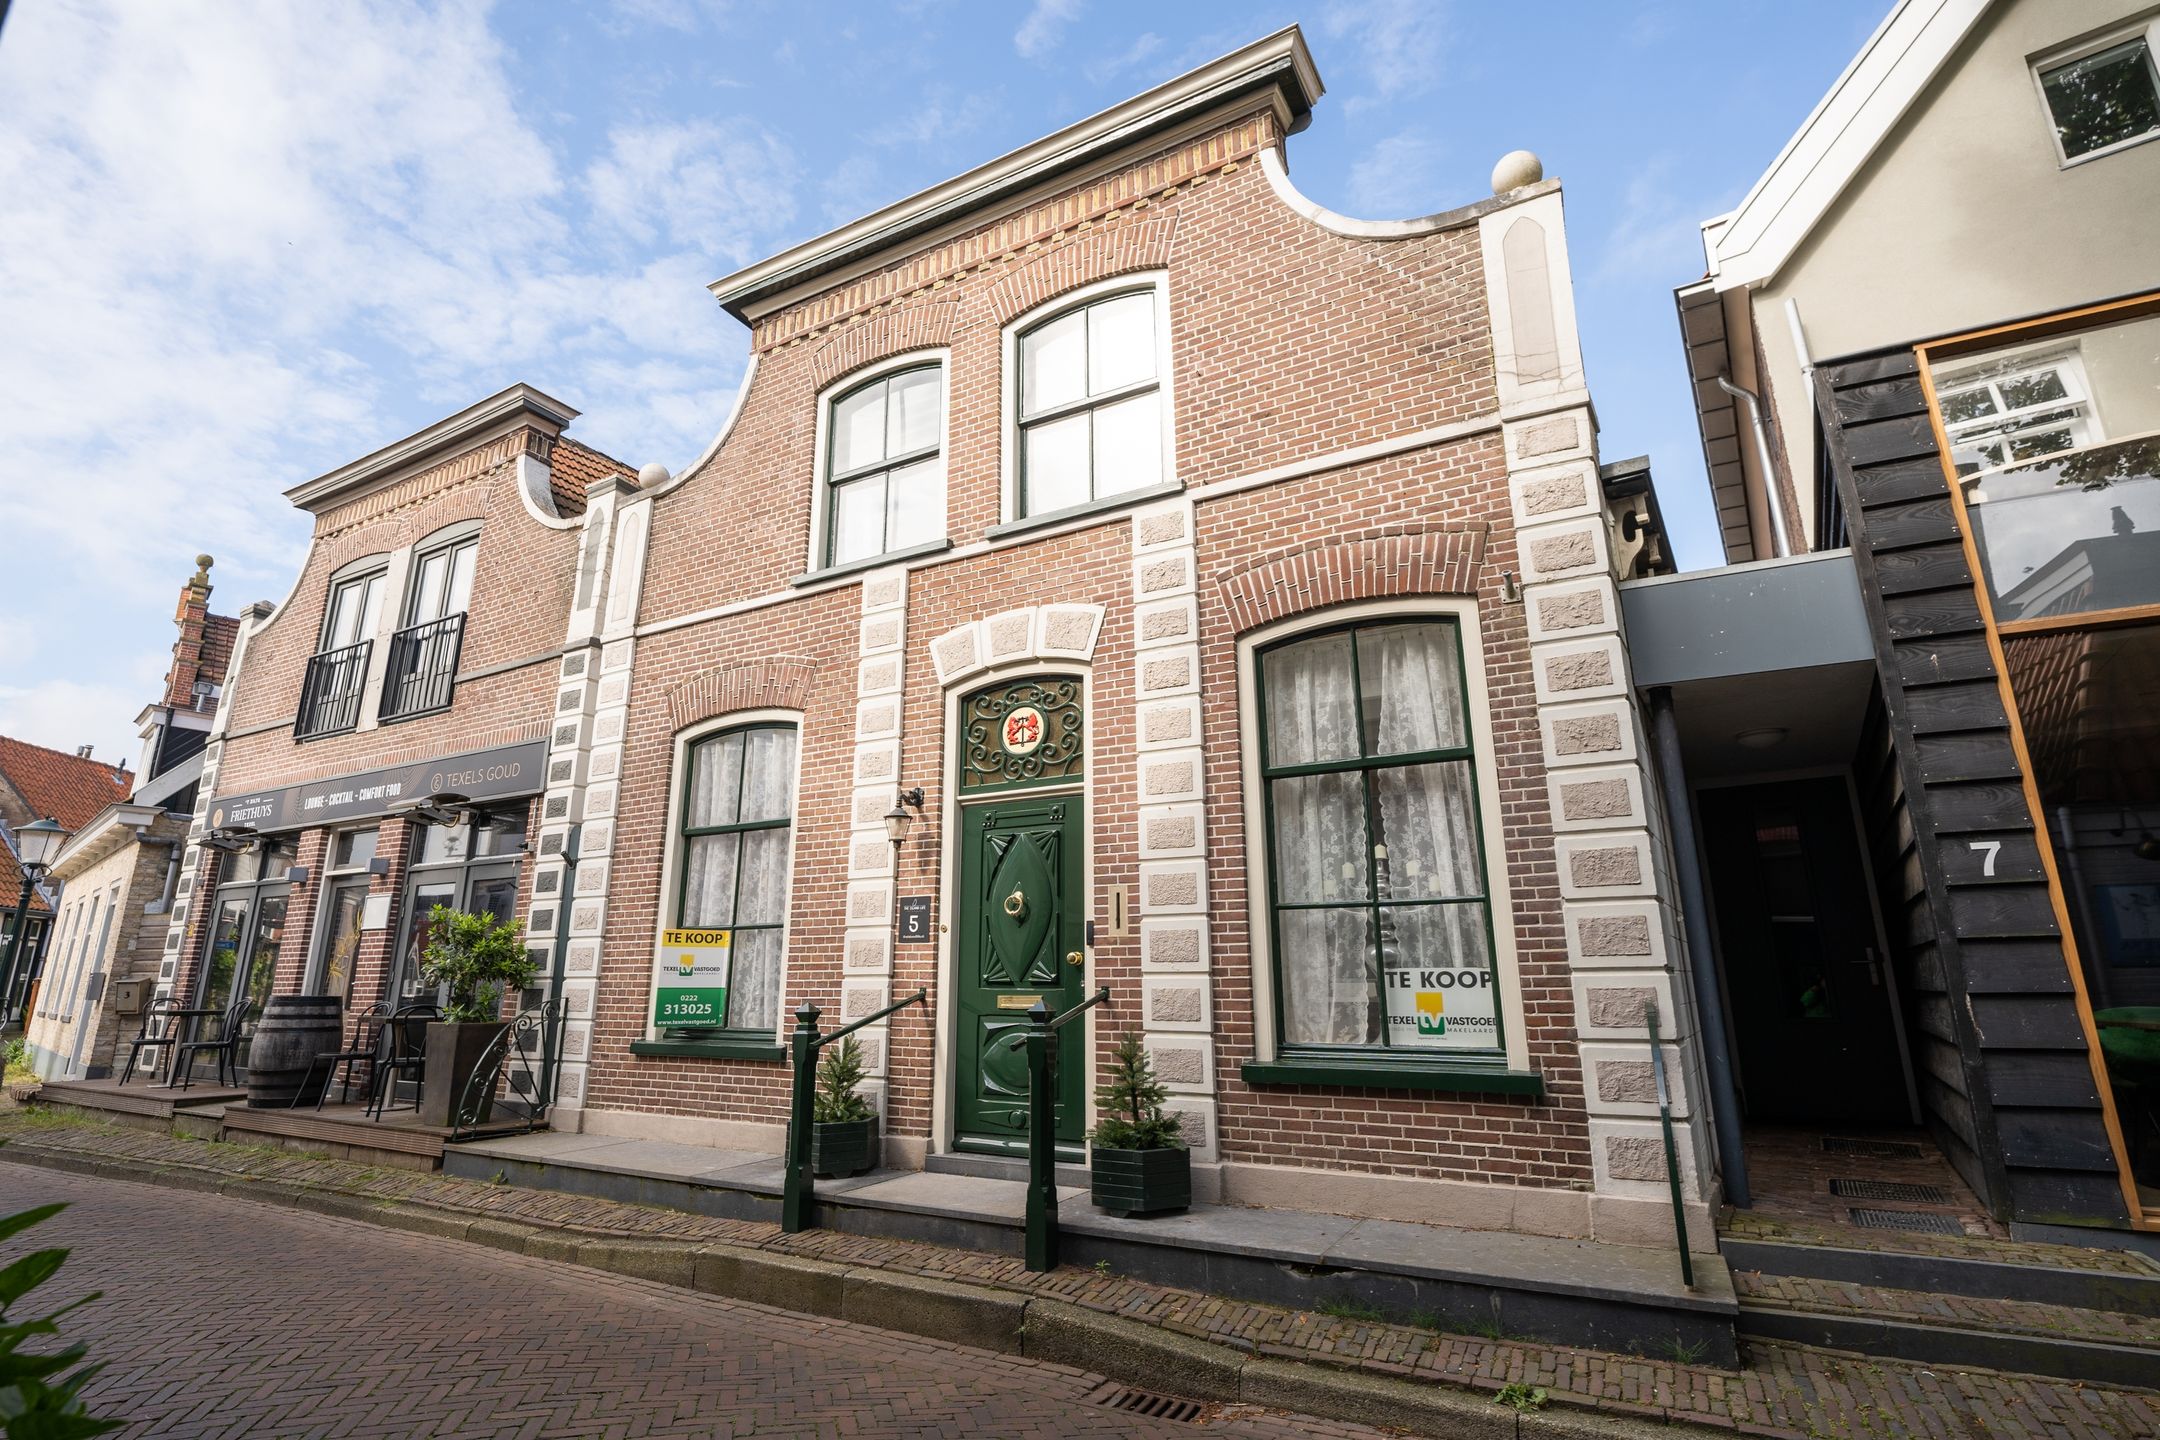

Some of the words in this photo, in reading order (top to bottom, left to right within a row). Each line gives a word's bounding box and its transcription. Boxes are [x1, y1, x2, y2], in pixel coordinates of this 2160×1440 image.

[447, 768, 484, 788] TEXELS
[486, 762, 521, 781] GOUD
[304, 795, 324, 809] LOUNGE
[329, 790, 353, 805] COCKTAIL
[359, 785, 386, 801] COMFORT
[385, 782, 402, 797] FOOD
[230, 804, 273, 822] FRIETHUYS
[1969, 841, 2001, 876] 7
[909, 915, 919, 933] 5
[666, 932, 682, 943] TE
[685, 932, 723, 944] KOOP
[1385, 971, 1411, 988] TE
[1420, 971, 1492, 988] KOOP
[123, 991, 130, 1000] 3
[664, 1003, 712, 1015] 313025
[1388, 1016, 1417, 1025] TEXEL
